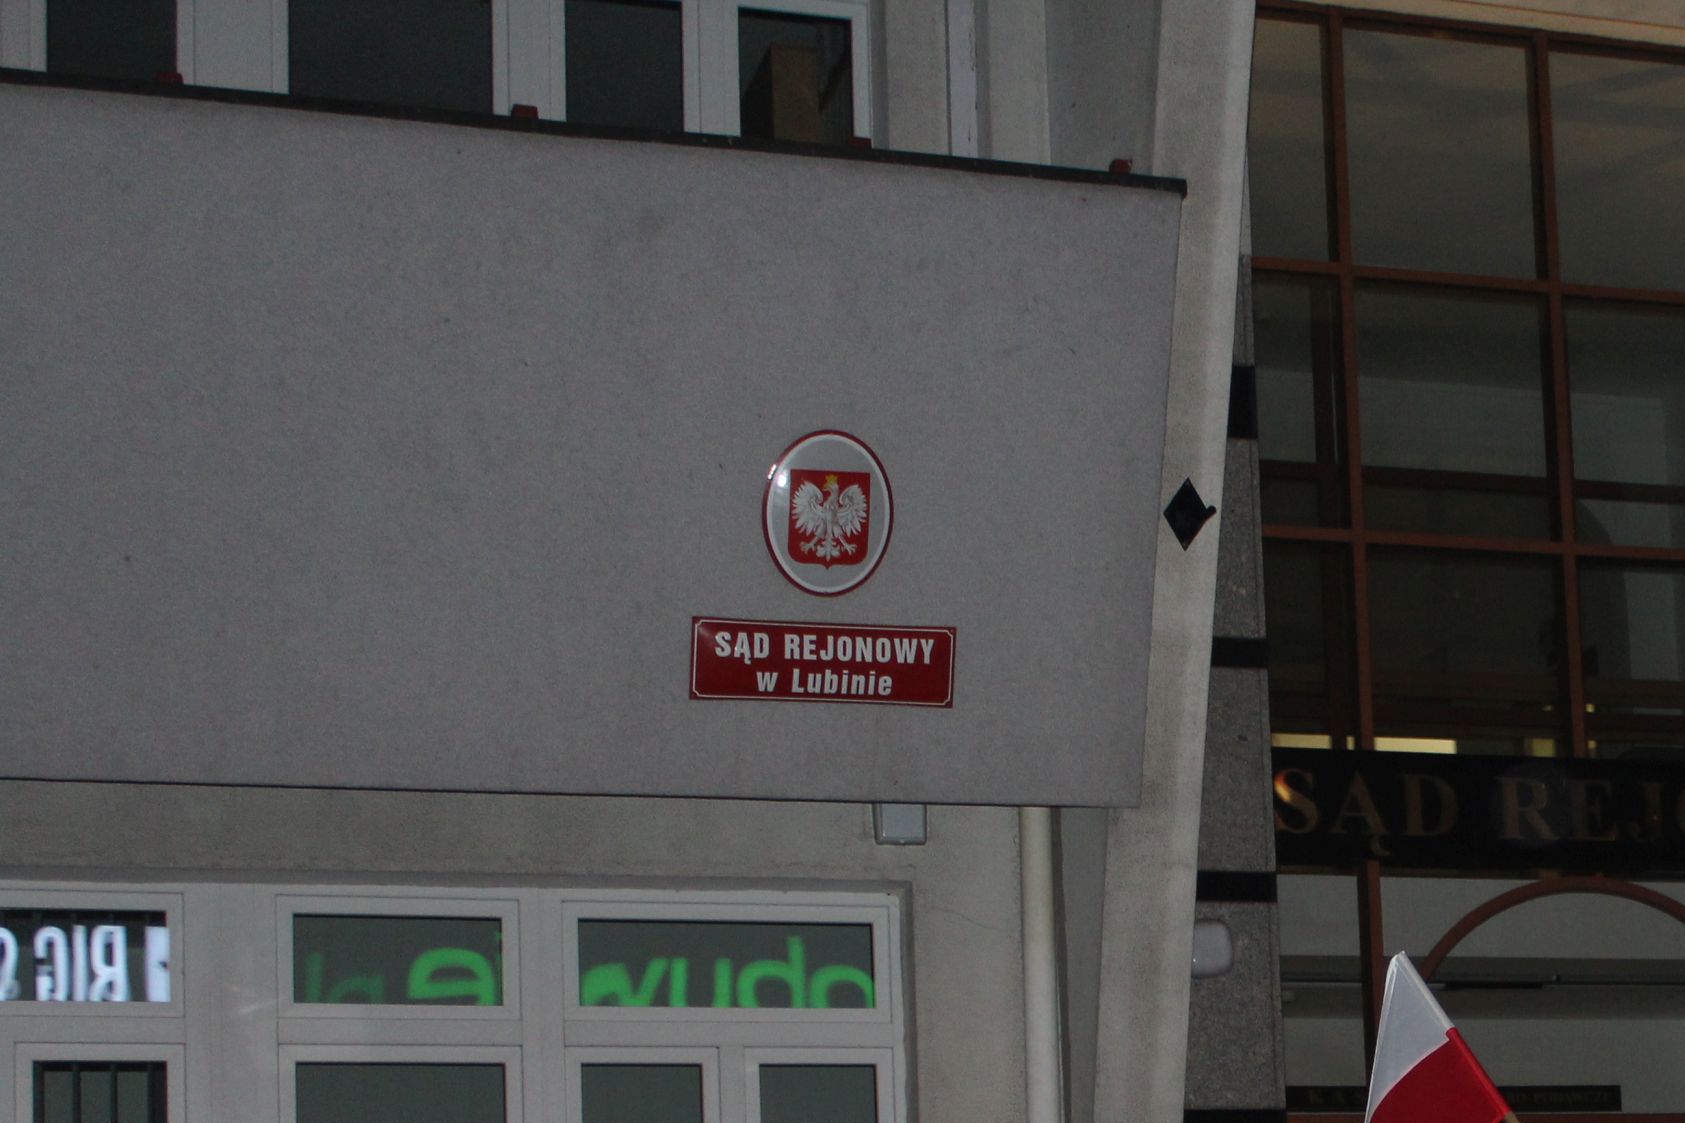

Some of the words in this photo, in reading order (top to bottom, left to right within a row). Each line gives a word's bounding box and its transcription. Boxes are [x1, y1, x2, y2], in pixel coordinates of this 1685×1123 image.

[714, 631, 770, 665] SĄD
[784, 633, 935, 664] REJONOWY
[756, 670, 778, 693] w
[791, 668, 893, 696] Lubinie
[1274, 767, 1458, 857] SĄD
